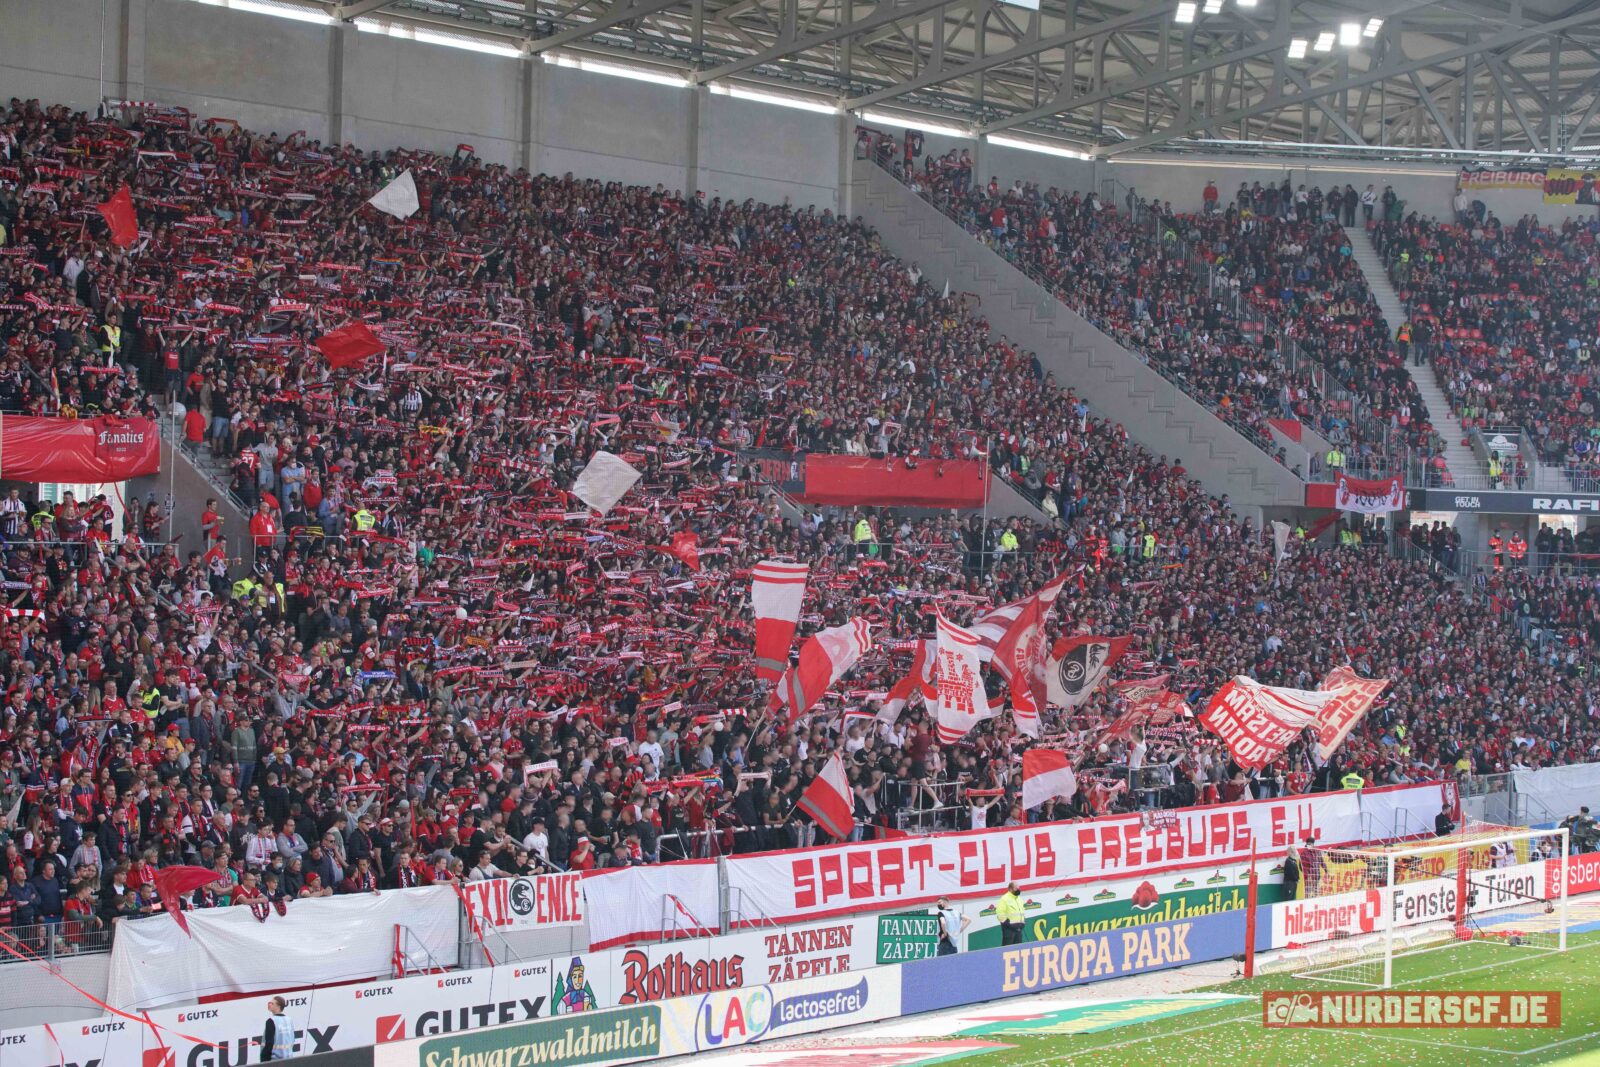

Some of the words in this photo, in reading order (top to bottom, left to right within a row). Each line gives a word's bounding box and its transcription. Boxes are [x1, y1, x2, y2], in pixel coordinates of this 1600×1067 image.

[1460, 171, 1545, 186] FREIBURG
[98, 430, 144, 446] Fanatics
[792, 832, 1056, 908] SPORT-CLUB
[1077, 811, 1251, 871] FREIBURG
[1392, 884, 1456, 922] Fenste
[1485, 874, 1535, 904] Türen
[1285, 898, 1356, 936] hilzinger
[765, 925, 853, 958] TANNEN
[1002, 936, 1114, 992] EUROPA
[1122, 922, 1191, 971] PARK
[445, 976, 473, 987] GUTEX
[521, 966, 547, 977] GUTEX
[618, 950, 745, 1004] Rothaus
[284, 997, 307, 1007] UTEX
[363, 986, 393, 998] GUTEX
[91, 1021, 126, 1034] GUTEX
[186, 1009, 219, 1021] GUTEX
[415, 995, 547, 1037] GUTEX
[705, 991, 766, 1045] LAC
[780, 989, 861, 1022] lactosefrei
[0, 1034, 26, 1046] UTEX
[186, 1025, 340, 1067] GUX
[425, 1016, 658, 1067] Schwarzwaldmilch
